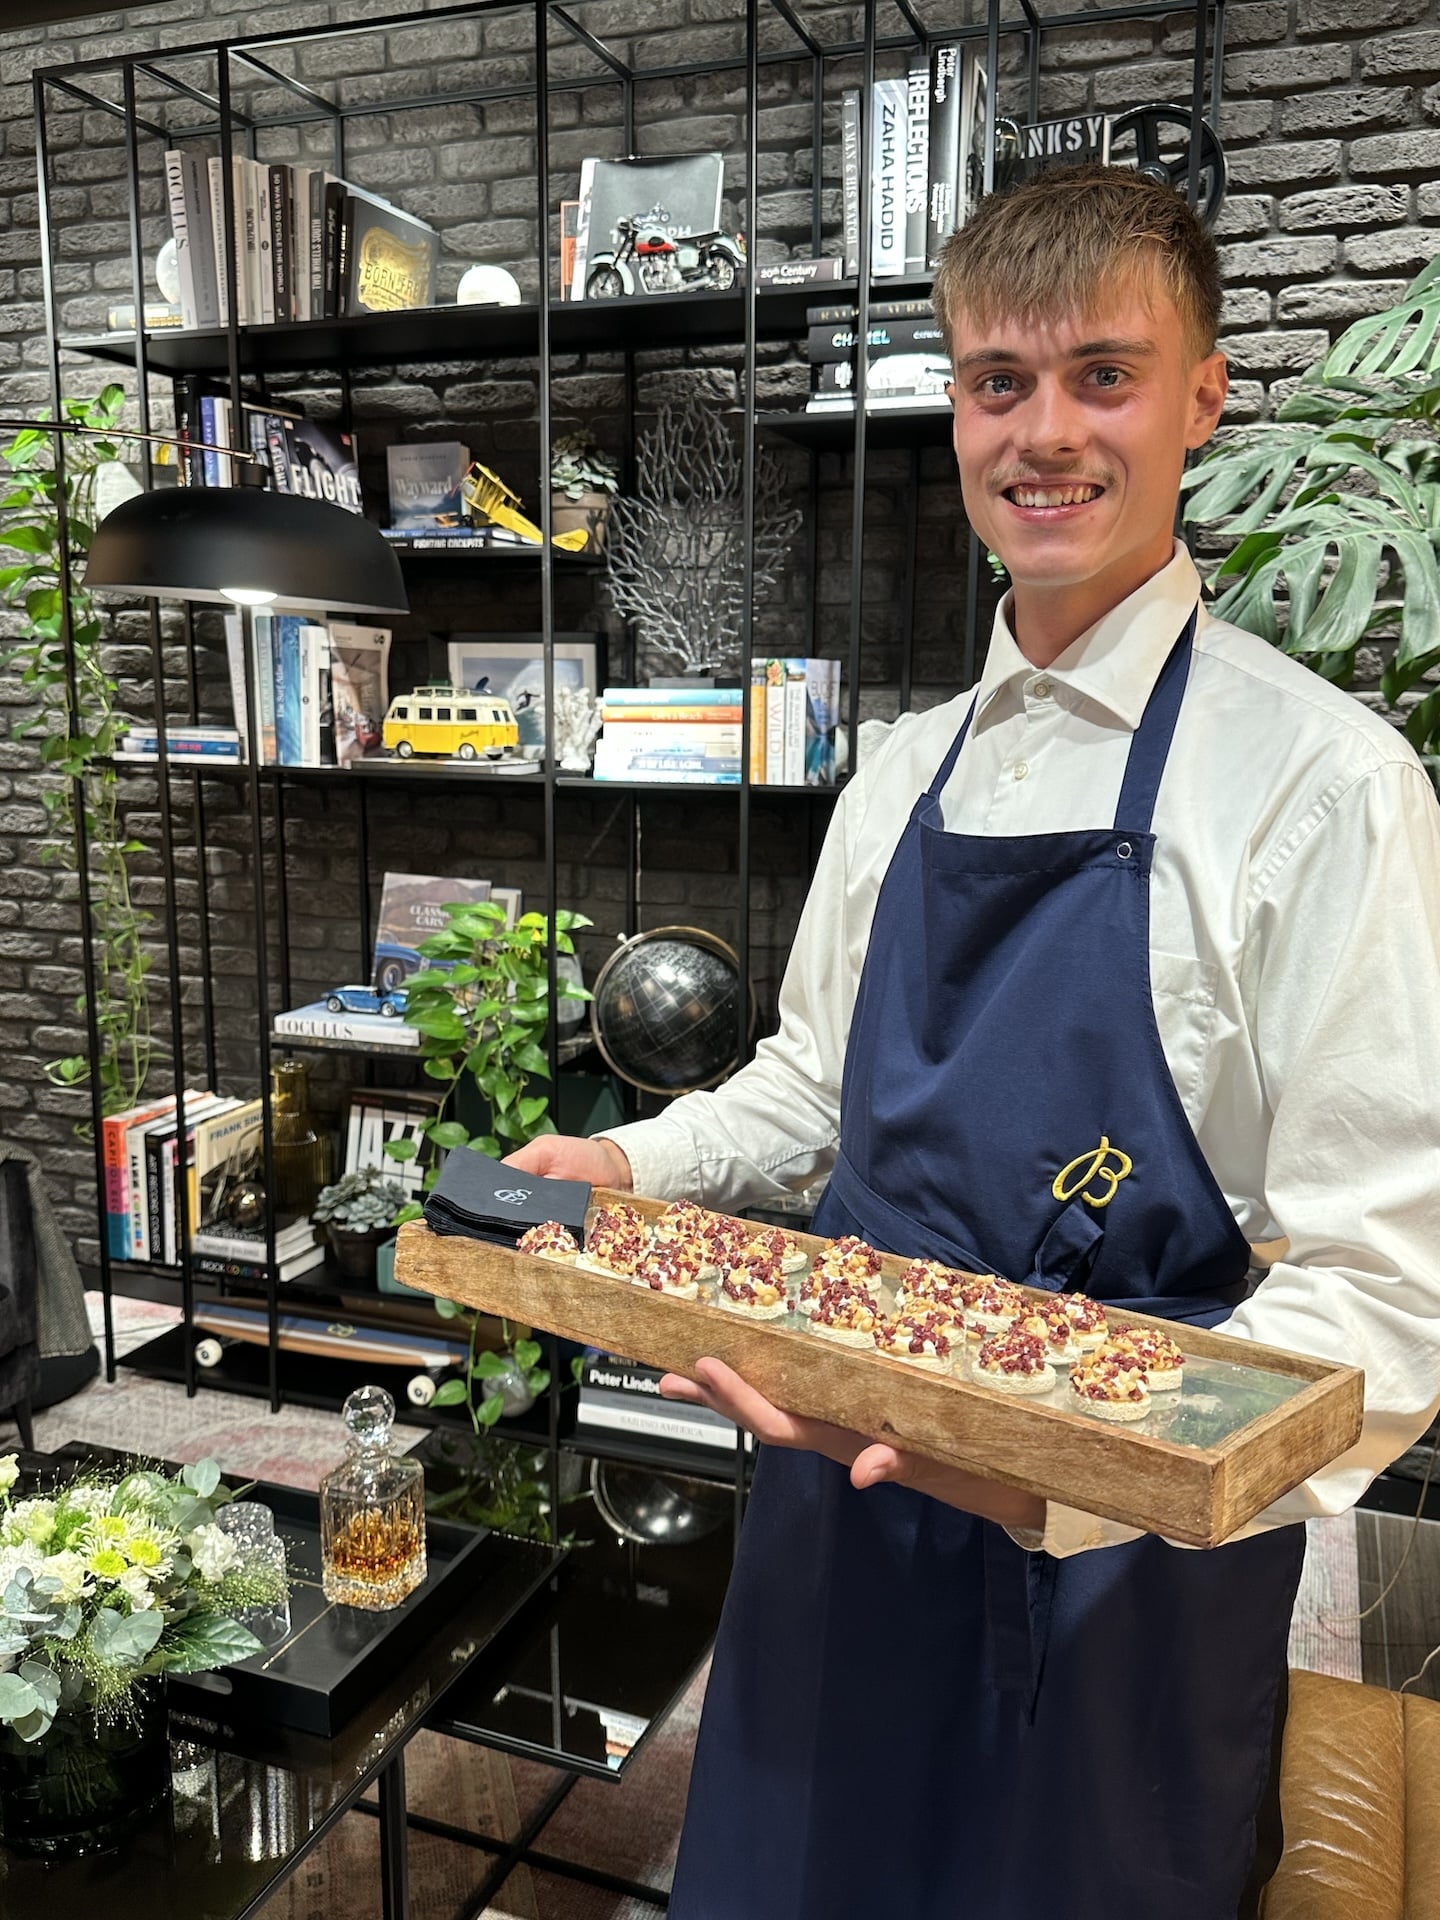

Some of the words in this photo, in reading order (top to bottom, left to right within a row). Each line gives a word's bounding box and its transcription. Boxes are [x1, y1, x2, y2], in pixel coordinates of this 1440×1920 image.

[934, 48, 946, 103] Lindbergh
[946, 47, 957, 78] Peter
[845, 133, 855, 160] MAN
[882, 103, 896, 170] ZAHA
[905, 74, 930, 214] REFLECTIONS
[1020, 115, 1103, 160] NKSY
[274, 185, 282, 209] WAYS
[845, 176, 856, 198] HIS
[168, 165, 189, 250] OCULUS
[881, 176, 895, 250] HADID
[275, 222, 283, 247] CYCLE
[311, 218, 321, 243] SOUTH
[846, 201, 857, 245] WATCH
[276, 249, 284, 263] THE
[312, 243, 321, 272] WHEELS
[276, 265, 284, 293] WORLD
[311, 273, 321, 290] TWO
[780, 263, 818, 279] Century
[290, 463, 359, 506] FLIGHT
[395, 475, 452, 500] Wayward
[447, 538, 484, 548] COCKPITS
[276, 664, 284, 685] Atlas
[277, 686, 286, 703] Surf
[277, 704, 285, 718] The
[768, 703, 783, 754] WILD
[415, 916, 444, 927] CARS
[287, 1018, 354, 1038] OCULUS
[208, 1122, 242, 1143] FRANK
[107, 1131, 120, 1185] CAPITOL
[148, 1153, 158, 1173] ART
[149, 1174, 160, 1214] RECORD
[132, 1193, 144, 1249] COVERS
[151, 1215, 161, 1254] COVERS
[589, 1368, 622, 1388] Peter
[622, 1374, 661, 1395] Lindbe
